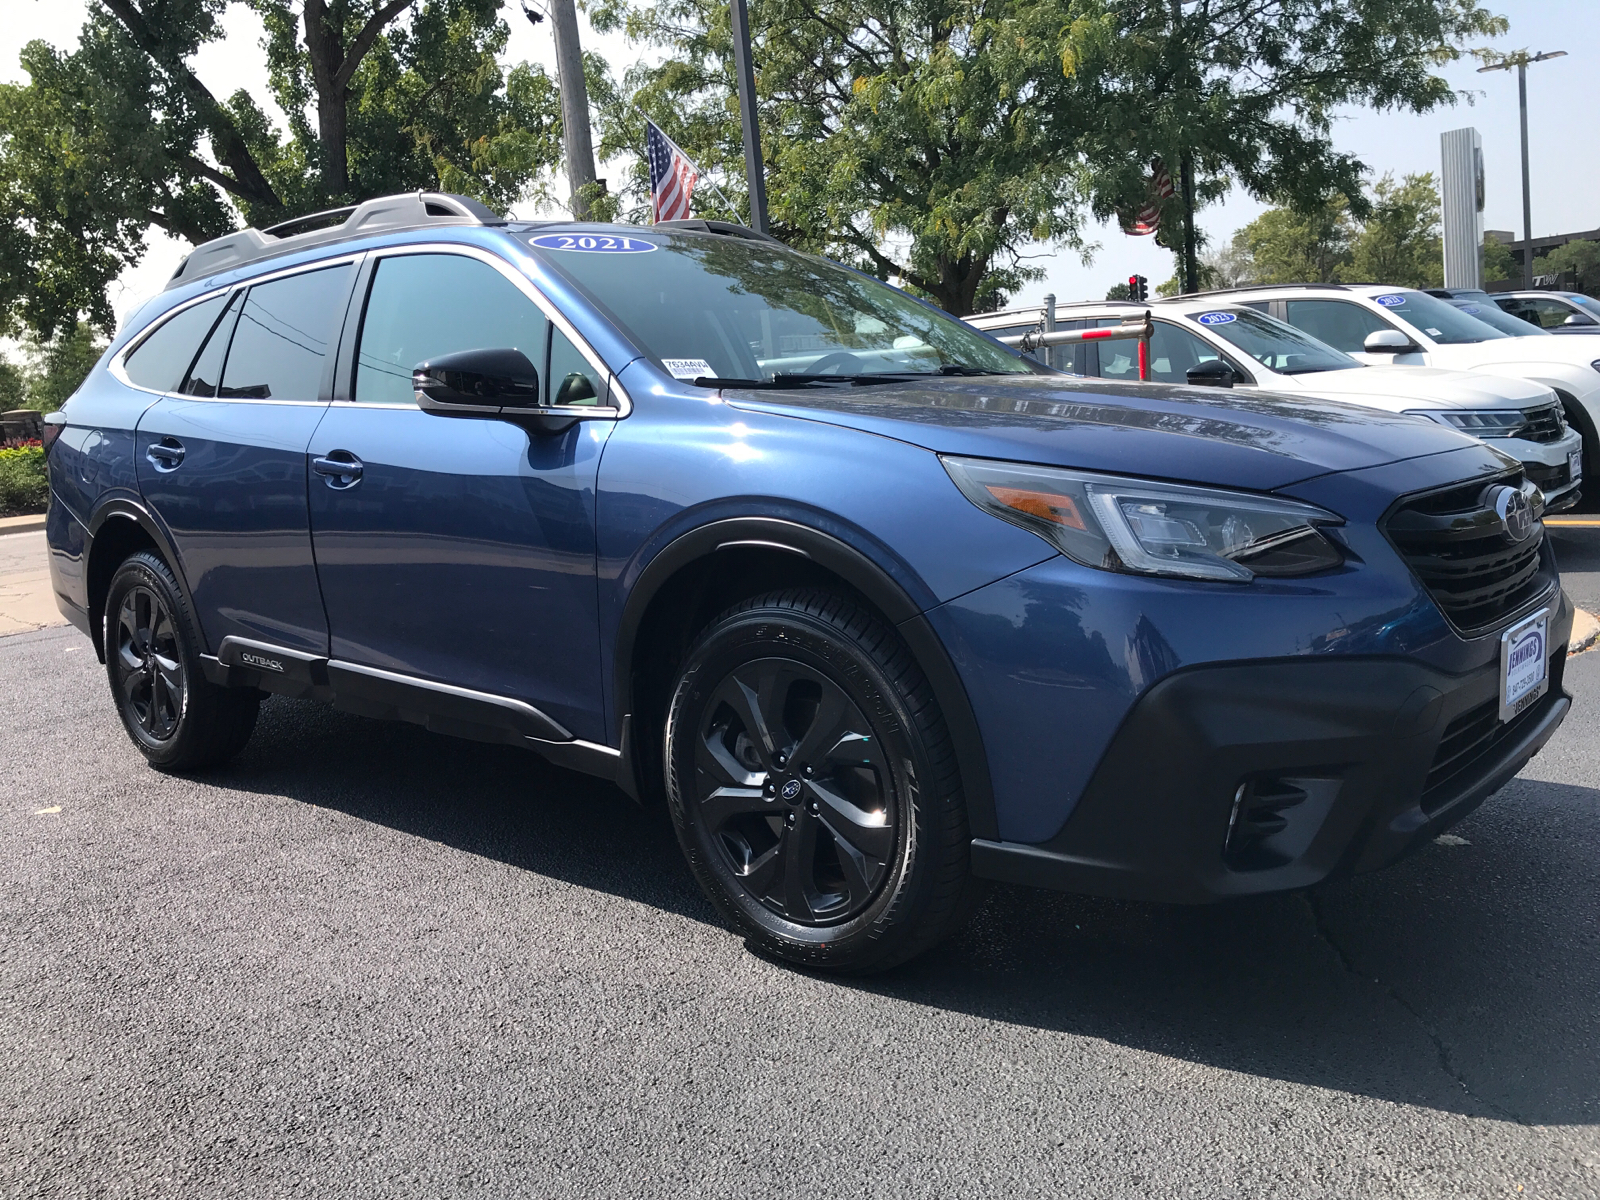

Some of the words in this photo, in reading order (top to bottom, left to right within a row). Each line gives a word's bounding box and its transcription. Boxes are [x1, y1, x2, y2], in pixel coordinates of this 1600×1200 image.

[557, 236, 635, 250] 2021
[1204, 312, 1231, 324] 2023
[242, 653, 284, 670] OUTBACK
[1507, 638, 1538, 677] JENNINGS
